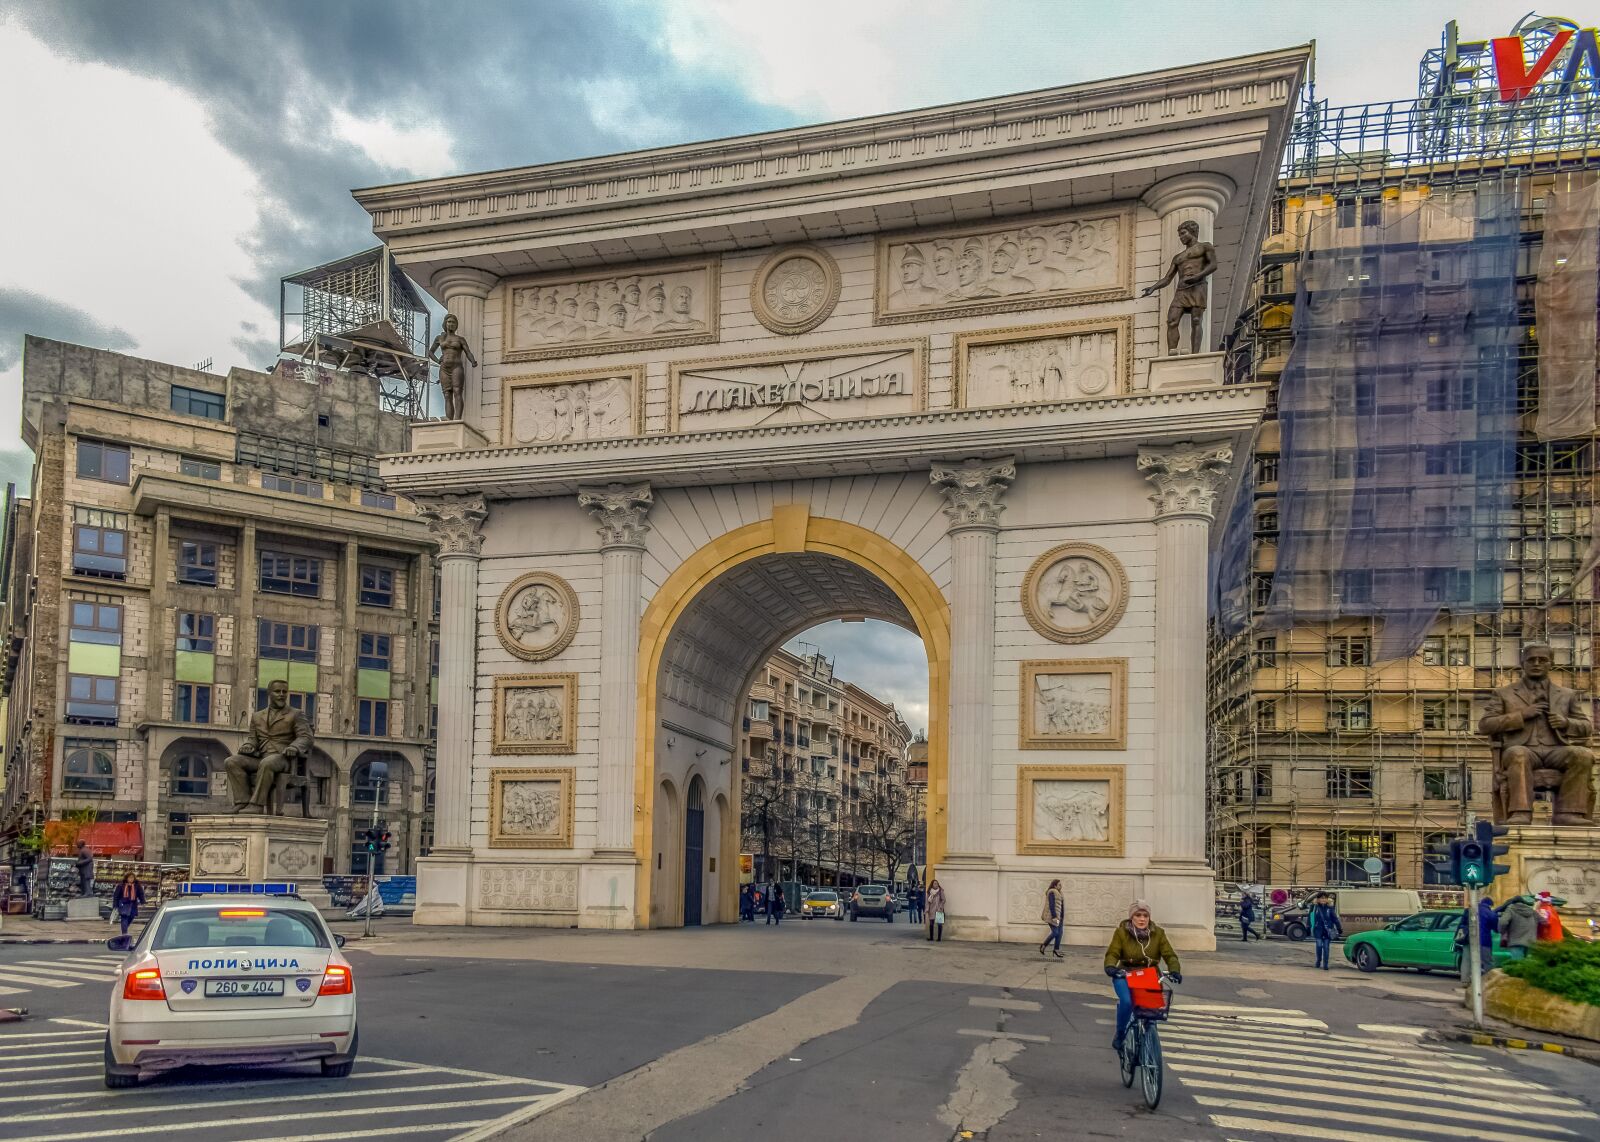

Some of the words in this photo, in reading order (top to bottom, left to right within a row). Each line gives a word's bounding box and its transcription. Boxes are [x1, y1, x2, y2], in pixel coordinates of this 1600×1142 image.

[687, 371, 904, 413] МАКЕДОНИЈА
[215, 981, 238, 993] 260
[252, 981, 274, 993] 404
